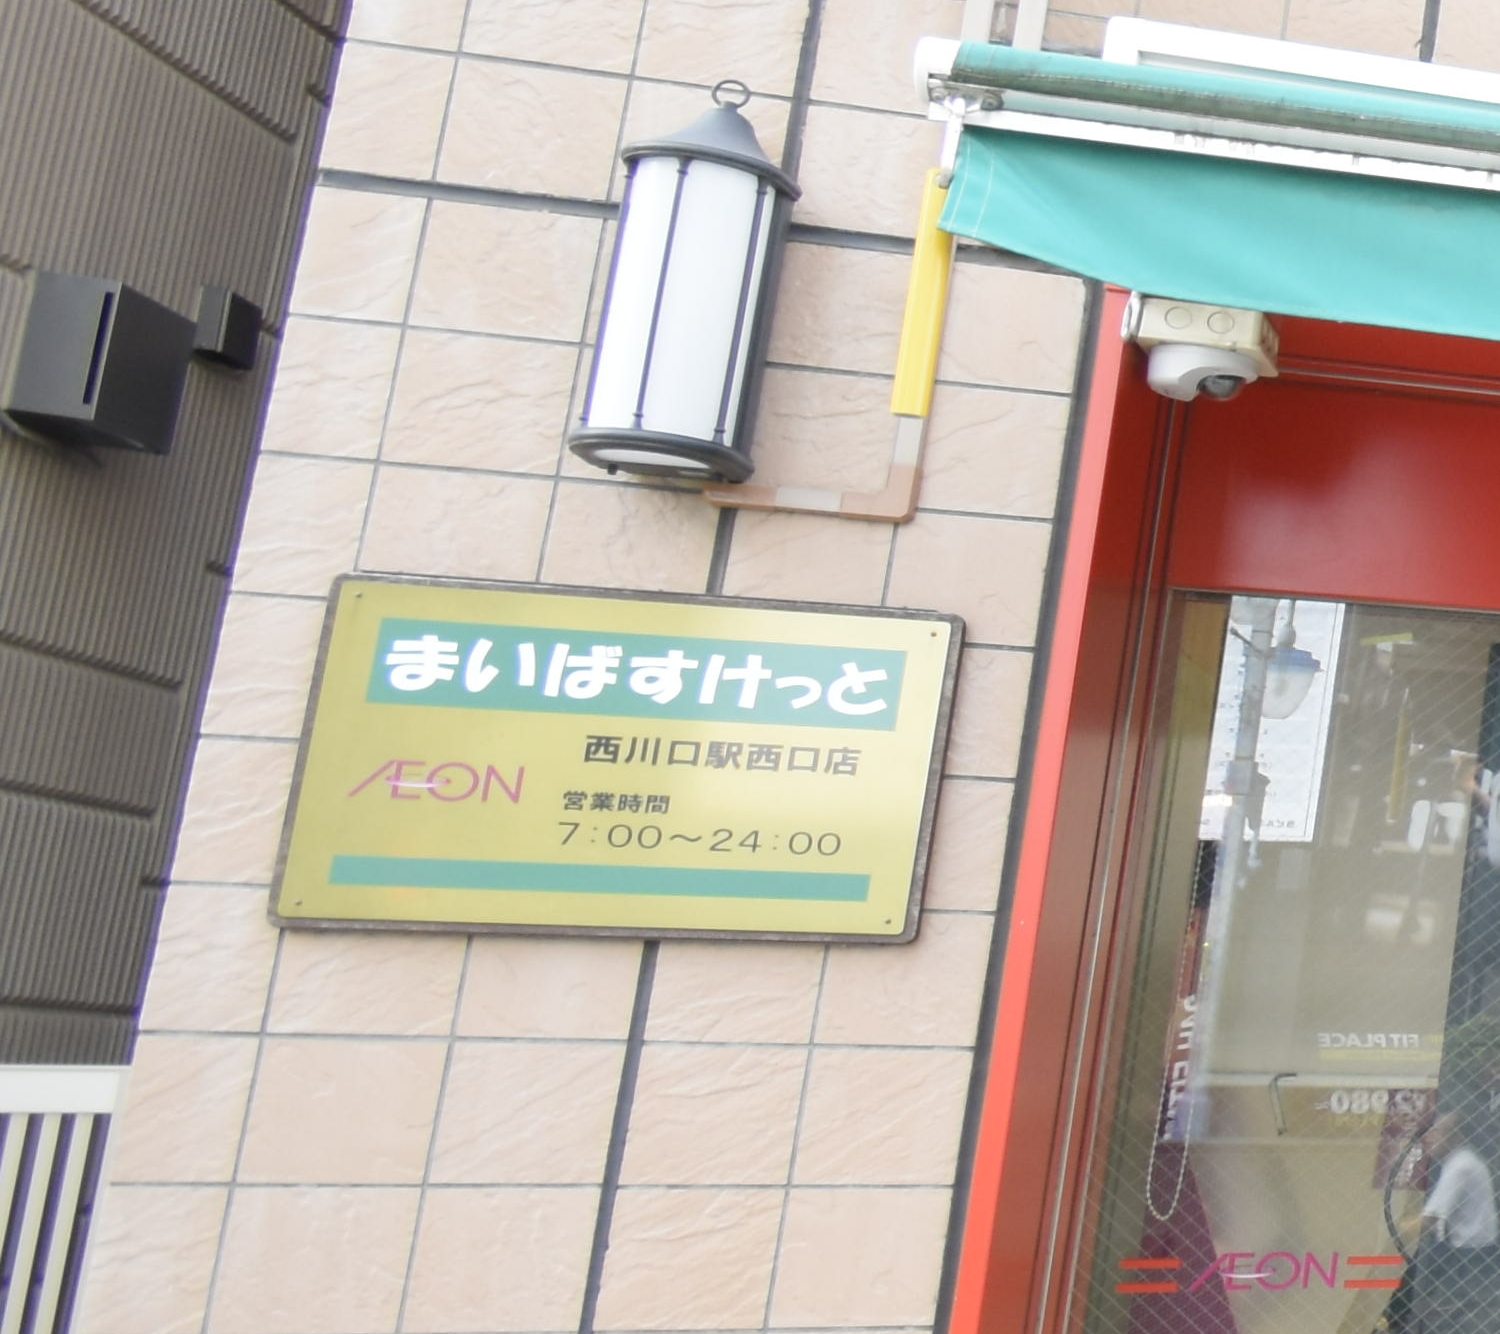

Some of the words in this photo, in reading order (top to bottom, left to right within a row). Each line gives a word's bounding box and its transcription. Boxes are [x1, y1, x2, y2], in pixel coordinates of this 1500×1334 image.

[384, 634, 889, 717] まいばすけっと
[582, 734, 862, 777] 西川口駅西口店
[561, 789, 671, 815] 営業時間
